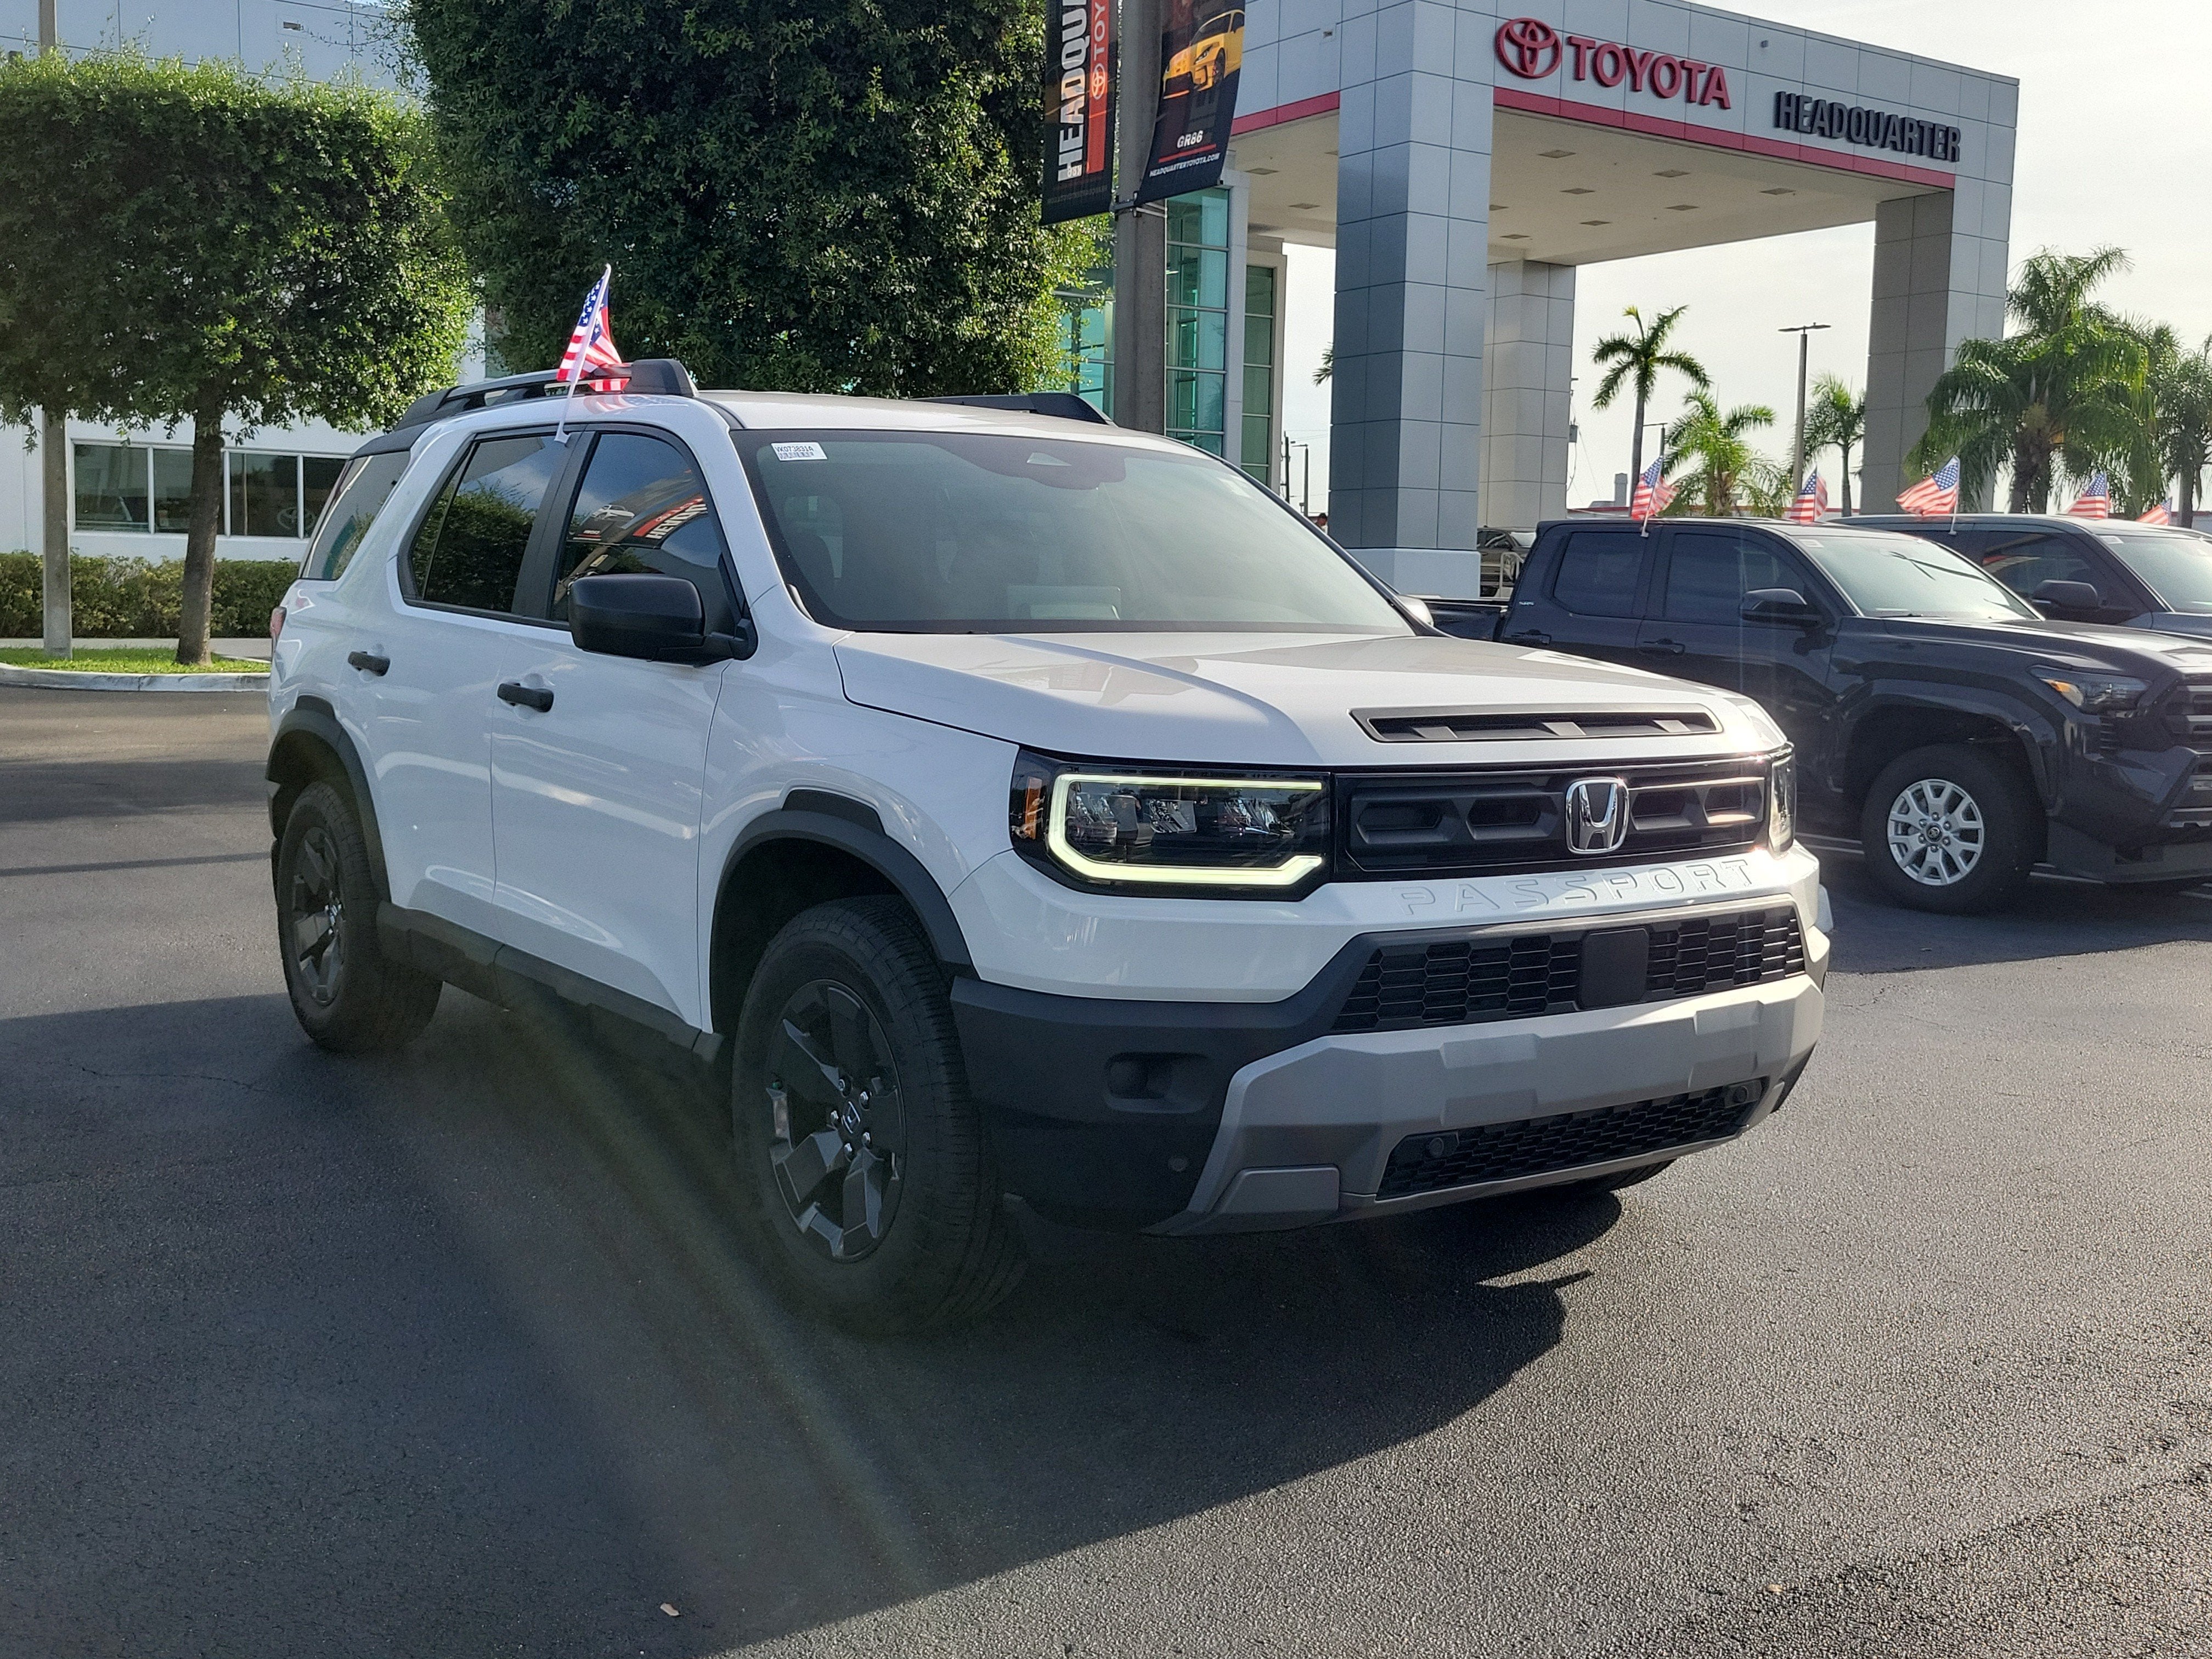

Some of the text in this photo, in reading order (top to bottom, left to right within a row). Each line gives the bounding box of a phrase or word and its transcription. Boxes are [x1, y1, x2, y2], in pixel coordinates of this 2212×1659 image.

[1058, 0, 1090, 182] HEADQU
[1567, 36, 1731, 109] TOYOTA
[1177, 130, 1204, 148] GR86
[1774, 91, 1961, 162] HEADQUARTER
[1391, 859, 1754, 916] PASSPORT
